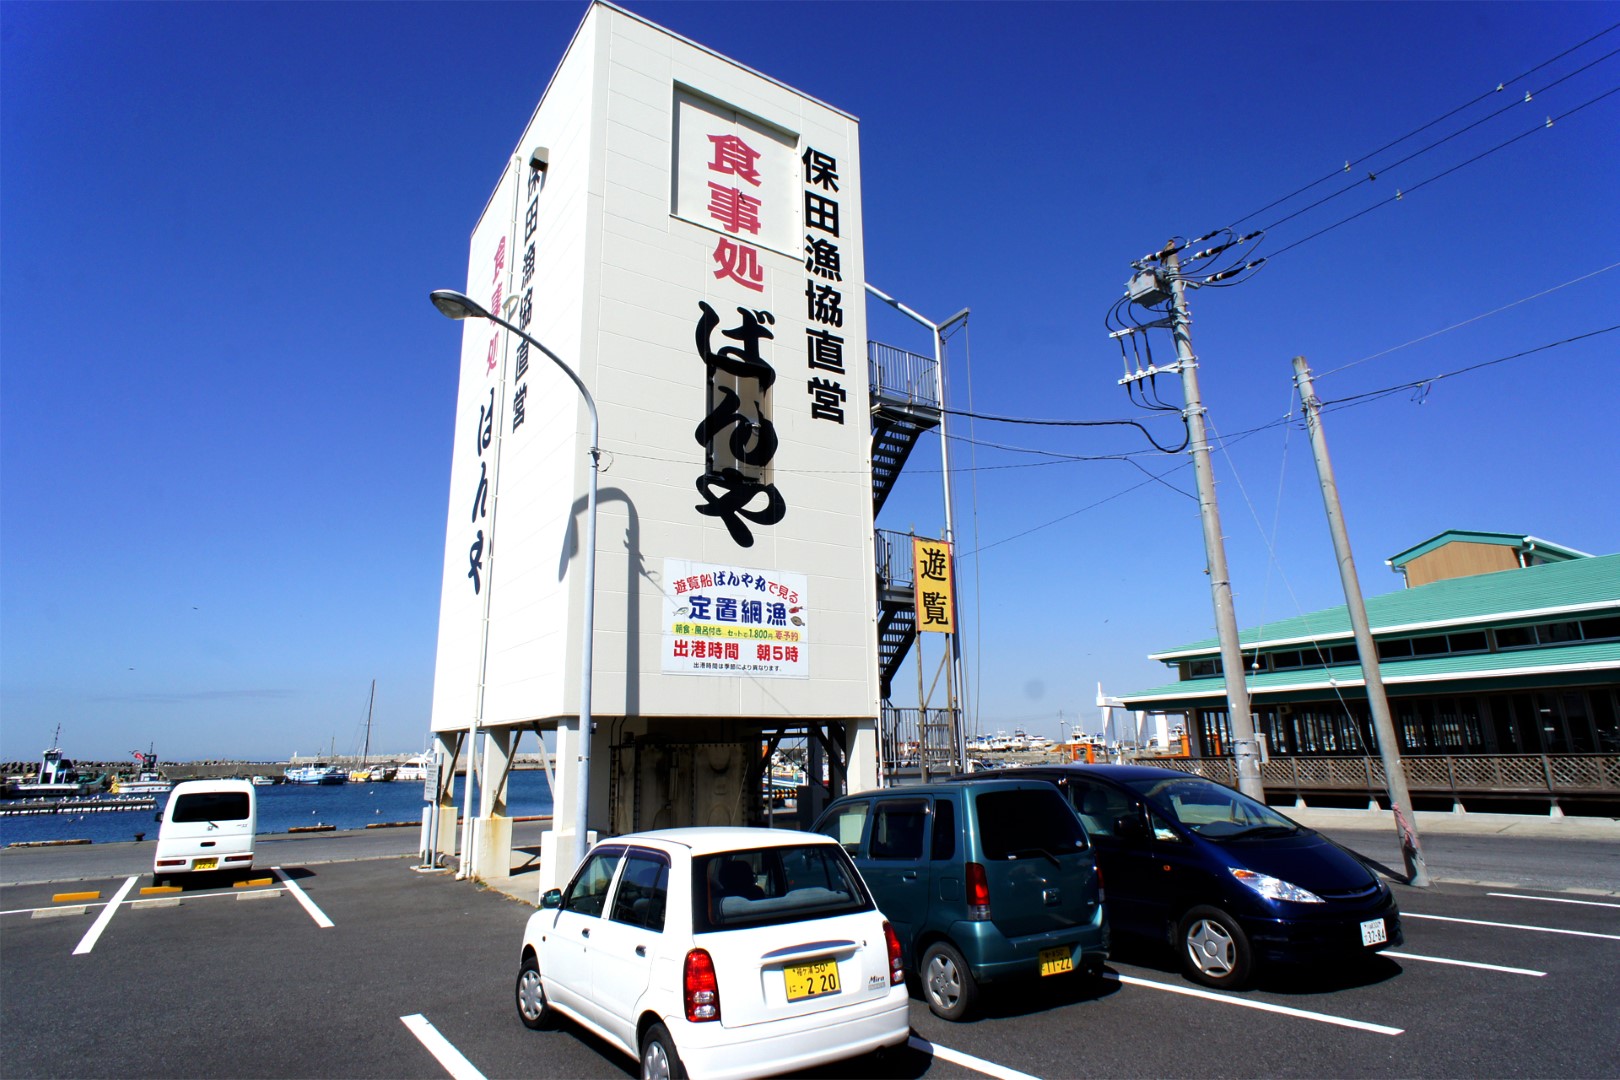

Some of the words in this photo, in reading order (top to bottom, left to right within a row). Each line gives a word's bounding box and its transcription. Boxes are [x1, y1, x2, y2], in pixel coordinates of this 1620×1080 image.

[706, 134, 764, 293] 食事処
[801, 146, 847, 425] 保田漁協直営
[694, 300, 787, 548] ばんや
[672, 571, 799, 604] 遊覧船ばんや丸で見る
[688, 595, 787, 627] 定置網漁
[920, 547, 949, 625] 遊覧
[673, 639, 739, 660] 出港時間
[756, 643, 799, 663] 朝5時
[868, 975, 885, 984] Mira
